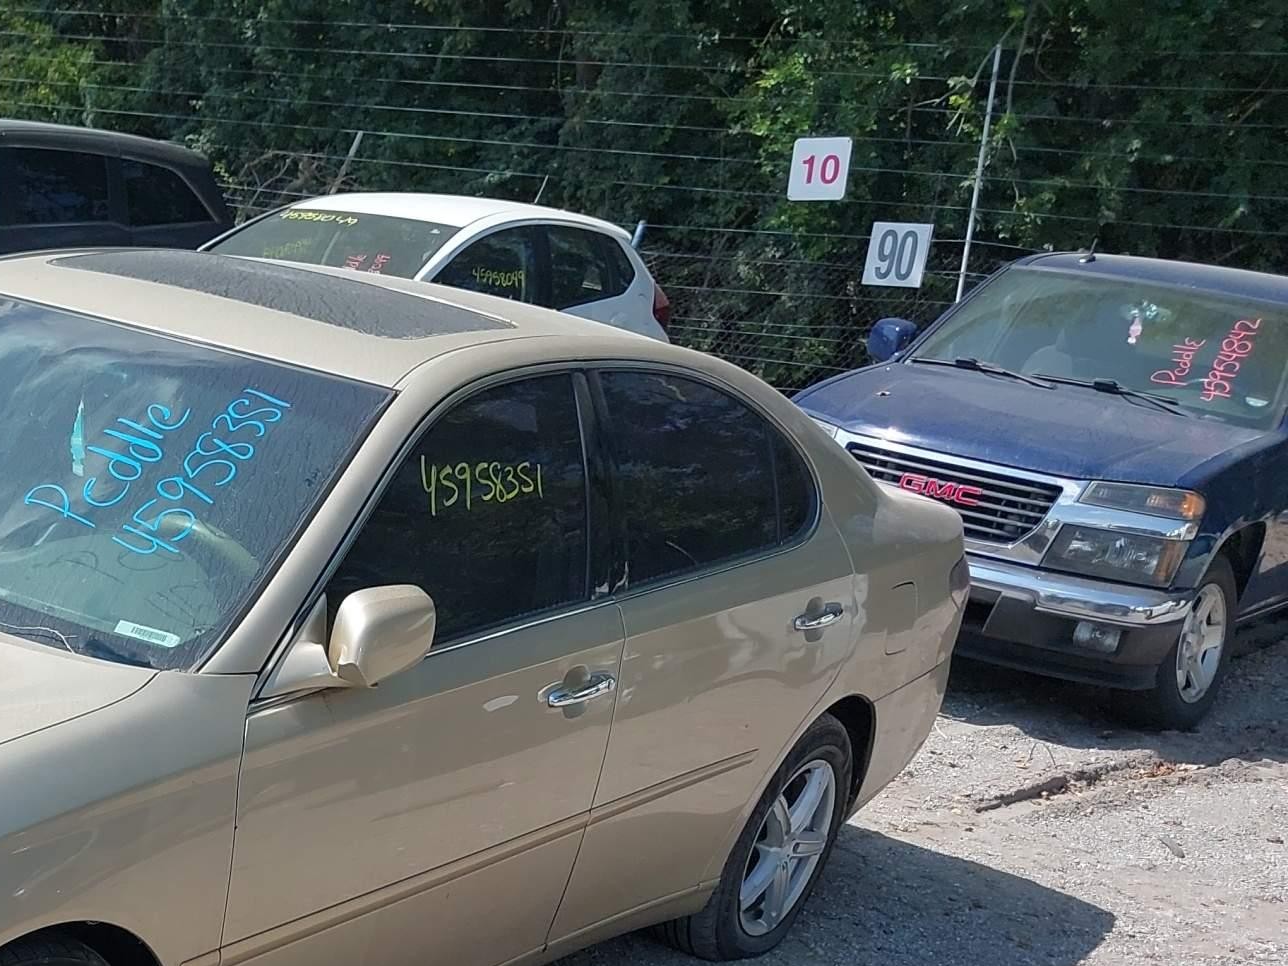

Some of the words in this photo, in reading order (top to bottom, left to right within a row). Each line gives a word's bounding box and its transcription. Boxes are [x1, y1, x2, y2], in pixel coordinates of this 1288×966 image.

[802, 154, 841, 185] 10
[874, 229, 919, 281] 90
[1150, 337, 1207, 386] Peddle
[1199, 318, 1262, 402] 45954842
[24, 403, 191, 528] Peddle
[112, 388, 292, 554] 45958351
[420, 454, 544, 516] 45958351
[900, 472, 983, 506] GMC
